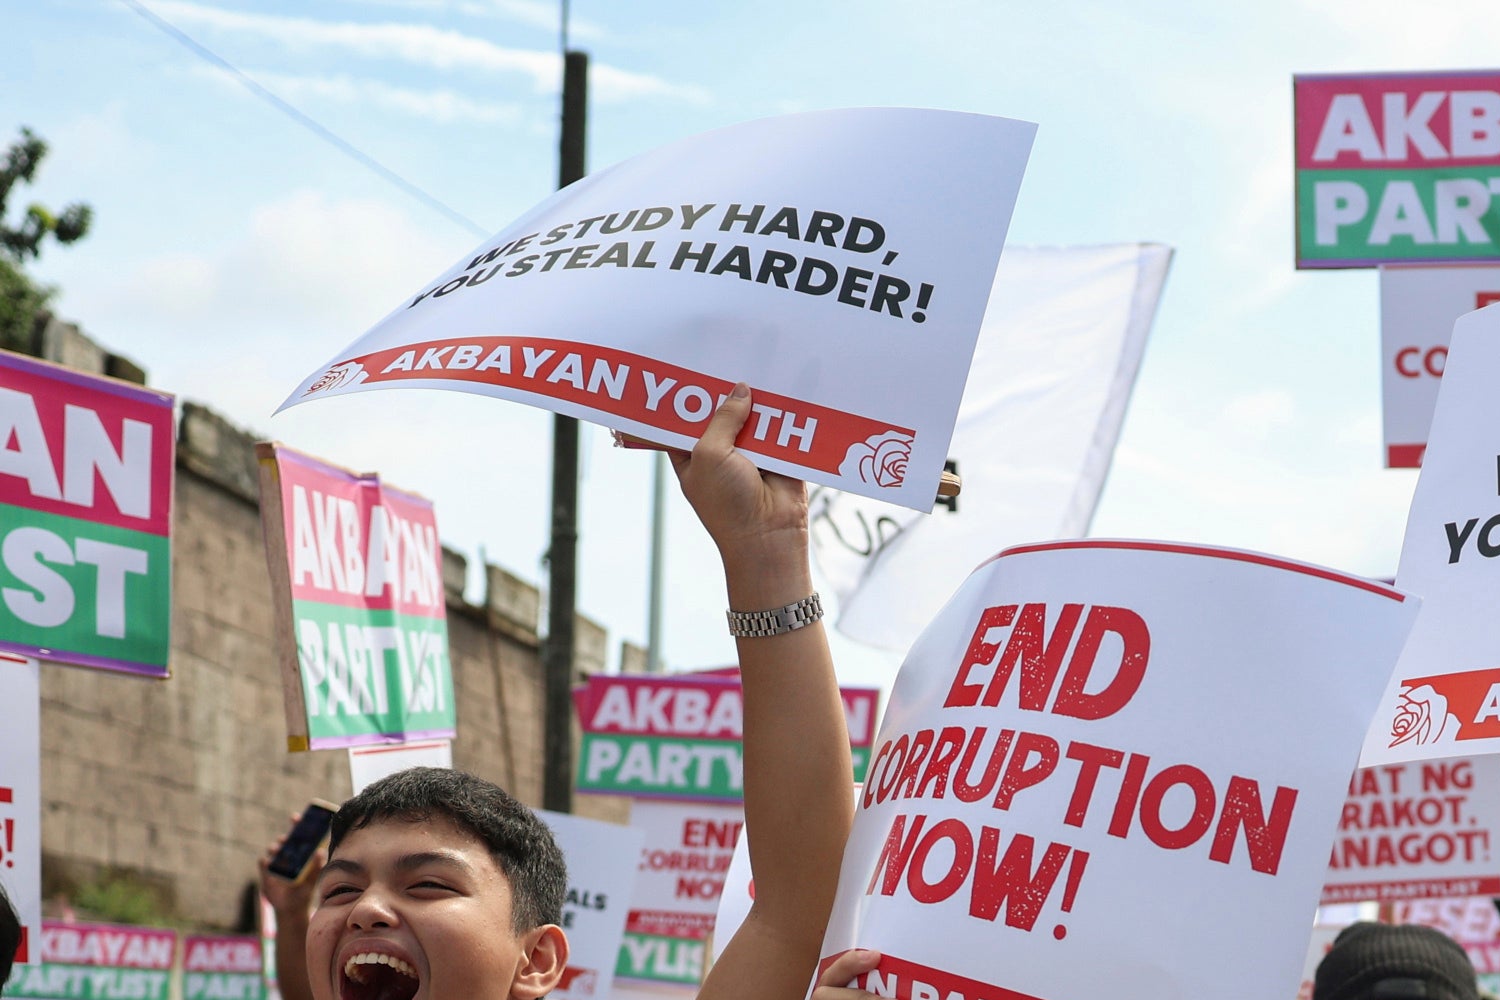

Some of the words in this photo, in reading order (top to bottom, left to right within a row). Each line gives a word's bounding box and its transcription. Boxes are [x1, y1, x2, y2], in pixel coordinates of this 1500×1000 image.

[466, 231, 535, 270] WE
[541, 203, 714, 247] STUDY
[717, 203, 899, 266] HARD,
[407, 263, 501, 309] YOU
[506, 240, 658, 278] STEAL
[669, 241, 934, 324] HARDER!
[381, 341, 631, 401] AKBAYAN
[642, 370, 818, 453] YOTH
[943, 602, 1151, 721] END
[586, 741, 743, 788] PARTY
[1422, 761, 1473, 792] NG
[864, 726, 1298, 877] CORRUPTION
[1340, 796, 1476, 830] RAKOT.
[866, 814, 1089, 941] NOW!
[1329, 830, 1489, 868] NAGOT!
[42, 928, 173, 968] KBAYAN
